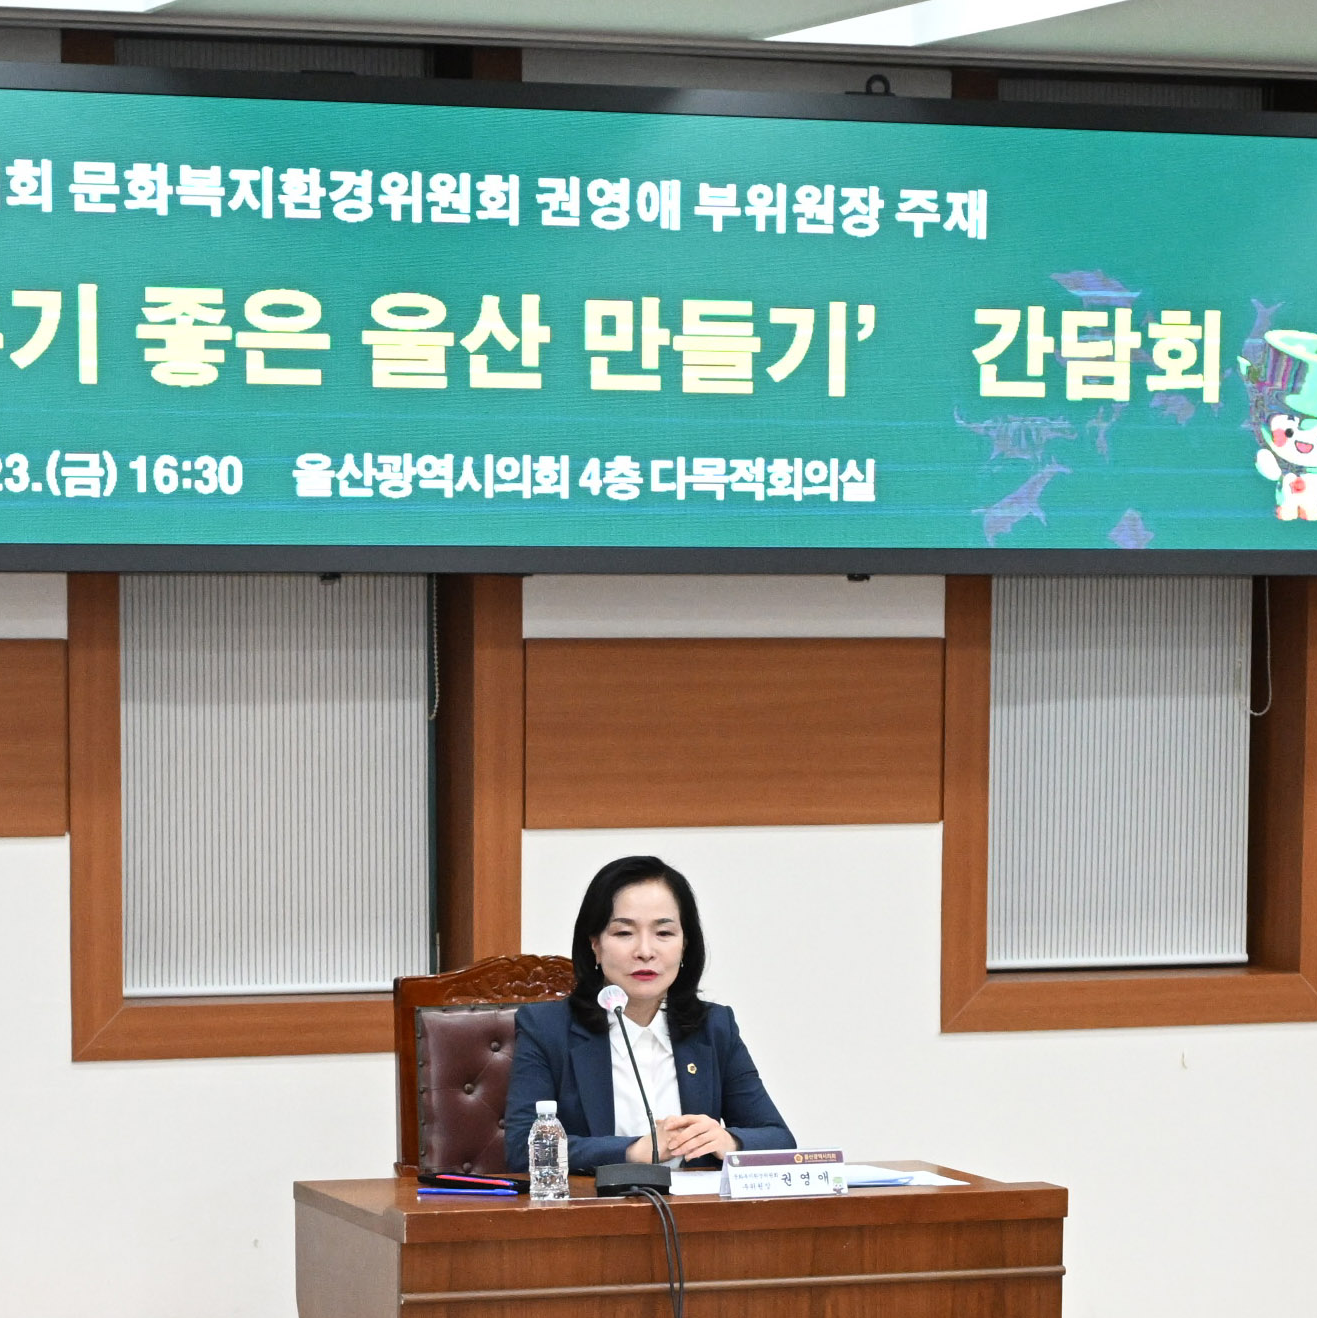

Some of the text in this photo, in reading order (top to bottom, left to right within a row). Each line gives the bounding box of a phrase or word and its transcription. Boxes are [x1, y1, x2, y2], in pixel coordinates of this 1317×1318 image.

[68, 161, 521, 227] 문화복지환경위원회
[535, 175, 681, 231] 권영애
[694, 182, 885, 238] 부위원장
[895, 189, 989, 241] 주재
[135, 286, 332, 389] 좋은
[360, 292, 552, 391] 울산
[971, 305, 1224, 404] 간담회
[129, 453, 244, 496] 16:30
[292, 451, 571, 501] 울산광역시의회
[578, 454, 645, 502] 4층
[649, 455, 877, 503] 다목적회의실
